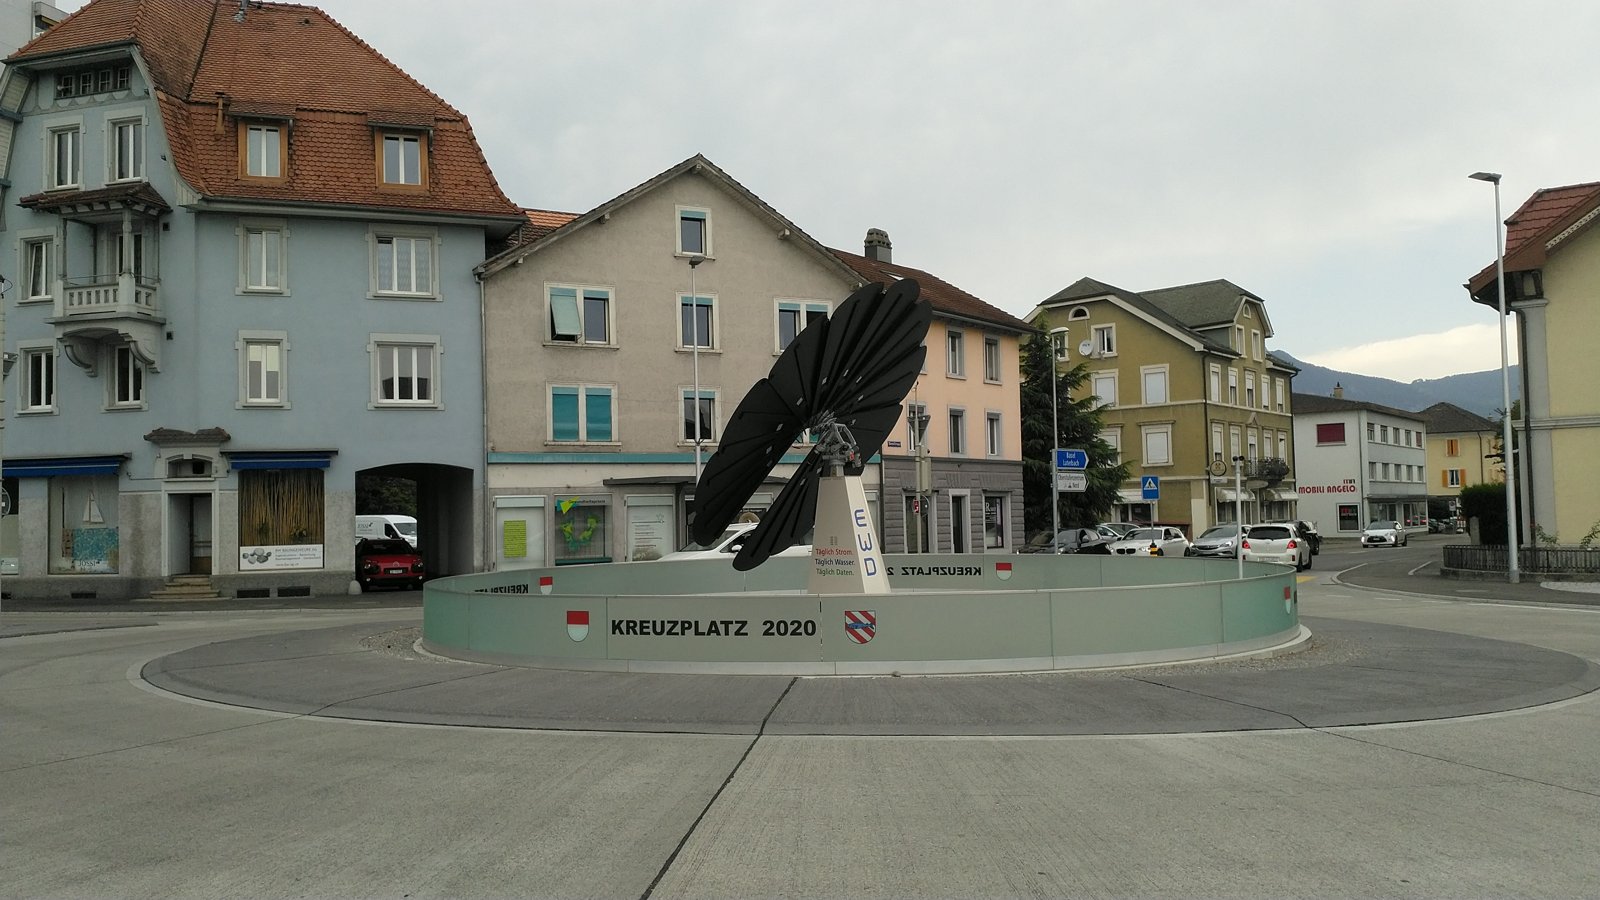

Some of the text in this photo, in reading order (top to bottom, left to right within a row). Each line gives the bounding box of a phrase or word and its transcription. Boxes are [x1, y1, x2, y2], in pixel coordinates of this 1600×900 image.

[1298, 485, 1356, 494] MOBILI ANGELO
[854, 509, 876, 576] EWD
[815, 548, 853, 556] Täglich Strom.
[815, 558, 834, 566] Täglich
[816, 568, 854, 576] Täglich Daten.
[611, 619, 817, 637] KREUZPLATZ 2020
